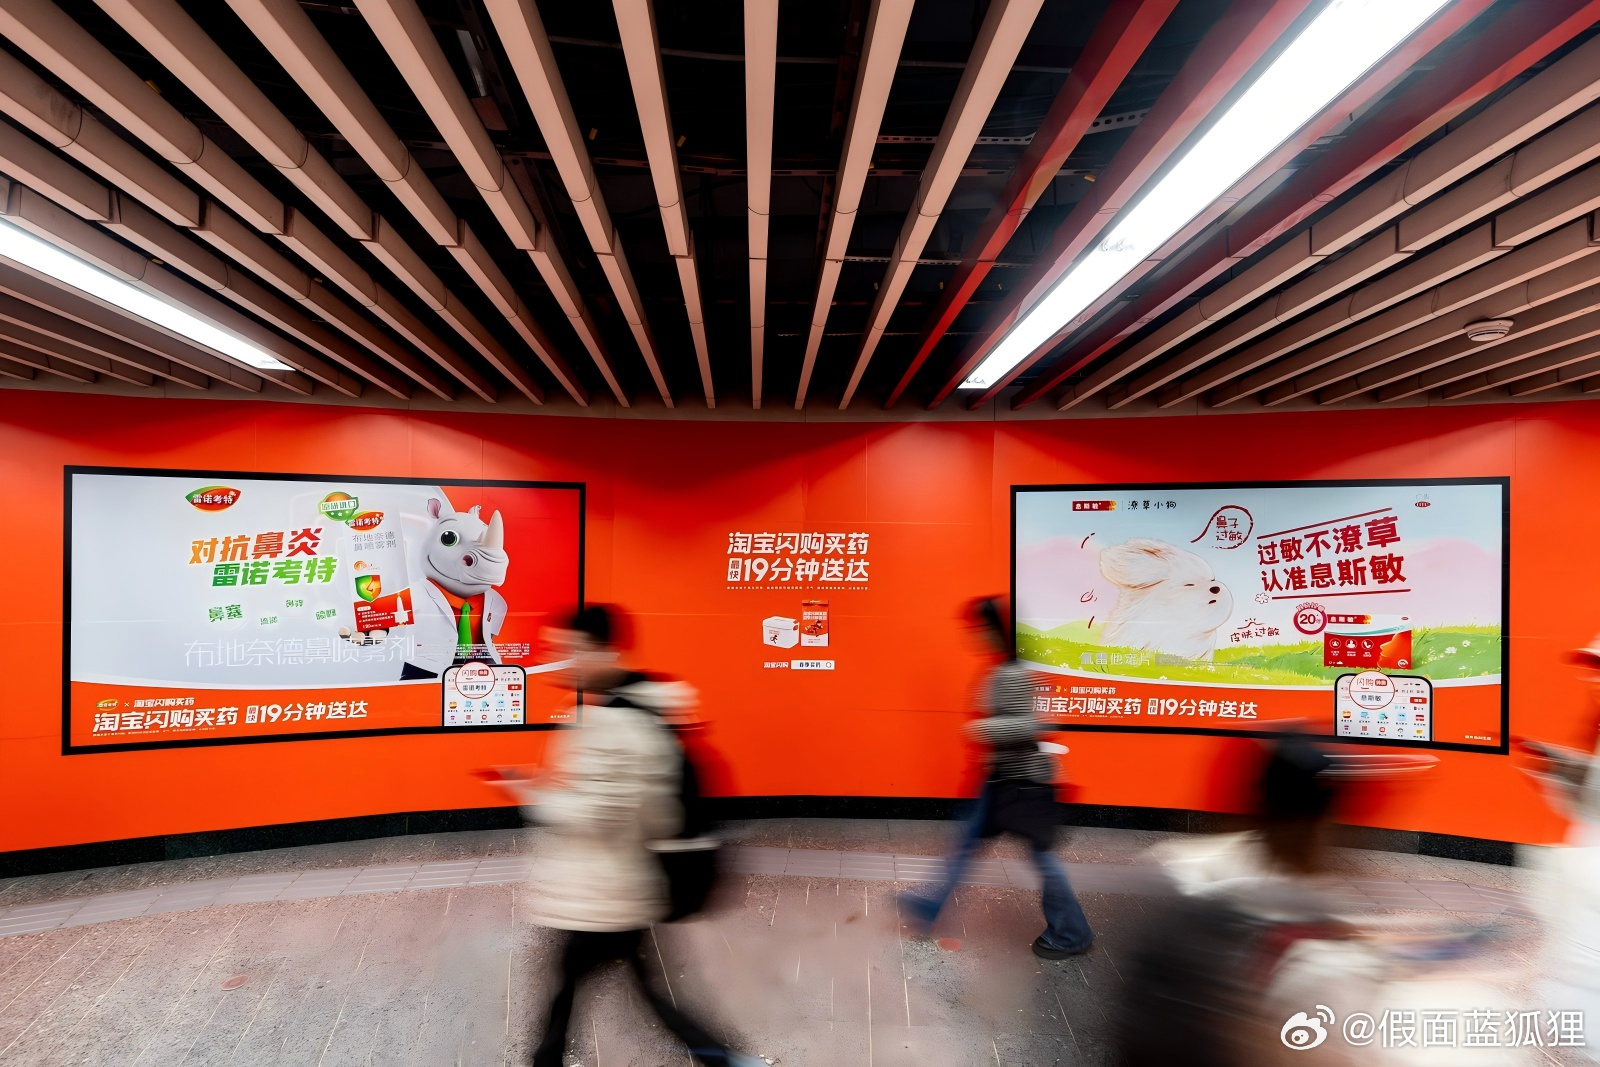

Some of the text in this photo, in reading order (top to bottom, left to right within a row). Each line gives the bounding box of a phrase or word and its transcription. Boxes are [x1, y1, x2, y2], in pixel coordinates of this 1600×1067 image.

[193, 494, 233, 504] 雷诺考特
[1127, 500, 1177, 510] 潦草小狗
[1216, 515, 1239, 529] 鼻子
[189, 528, 323, 564] 对抗鼻炎
[727, 532, 870, 555] 淘宝闪购买药
[1215, 530, 1243, 541] 过敏
[1257, 515, 1401, 566] 过敏不潦草
[212, 557, 337, 586] 雷诺考特
[744, 557, 870, 582] 19分钟送达
[1261, 553, 1407, 592] 认准息斯敏
[1230, 627, 1280, 642] 皮肤过敏
[184, 634, 415, 668] 布地奈德鼻喷雾剂
[93, 707, 239, 733] 淘宝闪购买药
[260, 700, 369, 723] 19分钟送达
[1160, 698, 1258, 719] 19分钟送达
